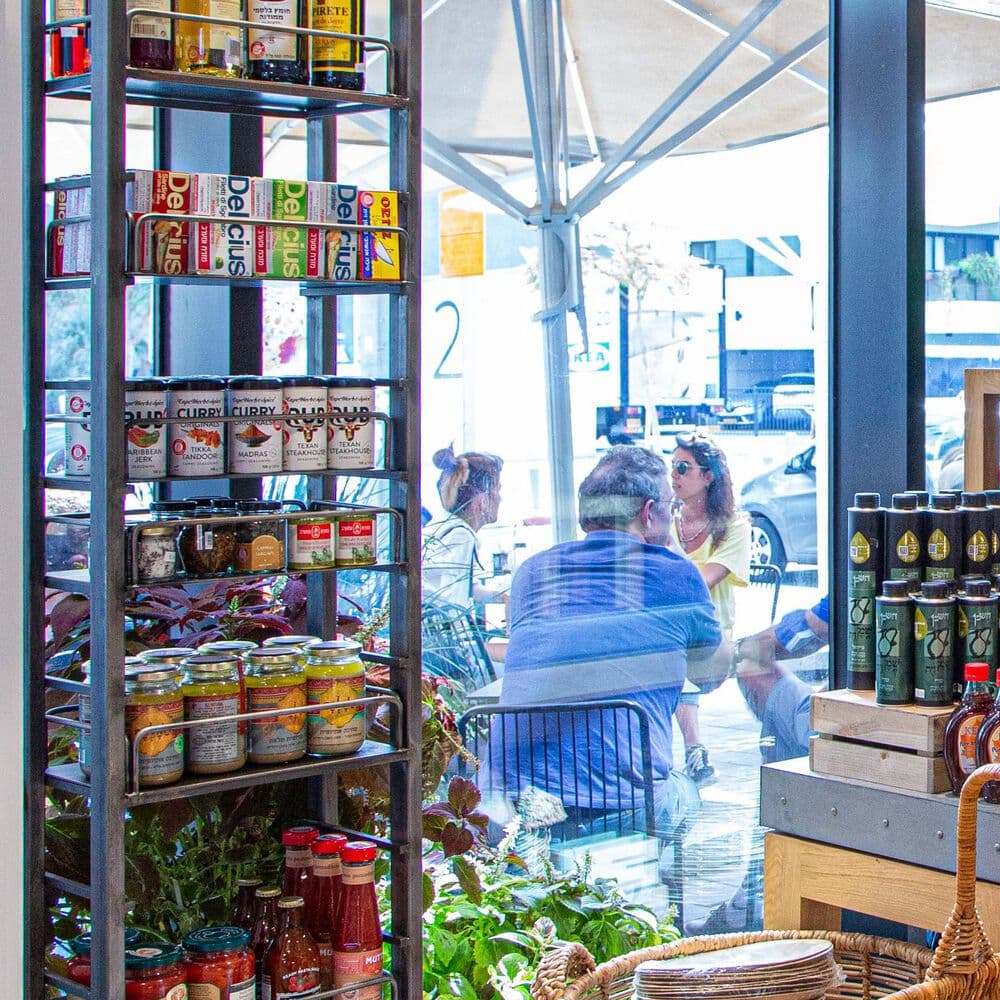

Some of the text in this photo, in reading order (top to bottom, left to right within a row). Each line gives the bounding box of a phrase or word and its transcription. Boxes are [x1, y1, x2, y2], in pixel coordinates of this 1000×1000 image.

[164, 172, 191, 275] Delcius
[227, 176, 250, 277] Delcius
[283, 181, 306, 278] Delcius
[335, 185, 357, 281] Delcius
[381, 197, 391, 239] ORTZ
[434, 301, 463, 379] 2
[177, 408, 222, 418] CURRY
[232, 406, 276, 416] CURRY
